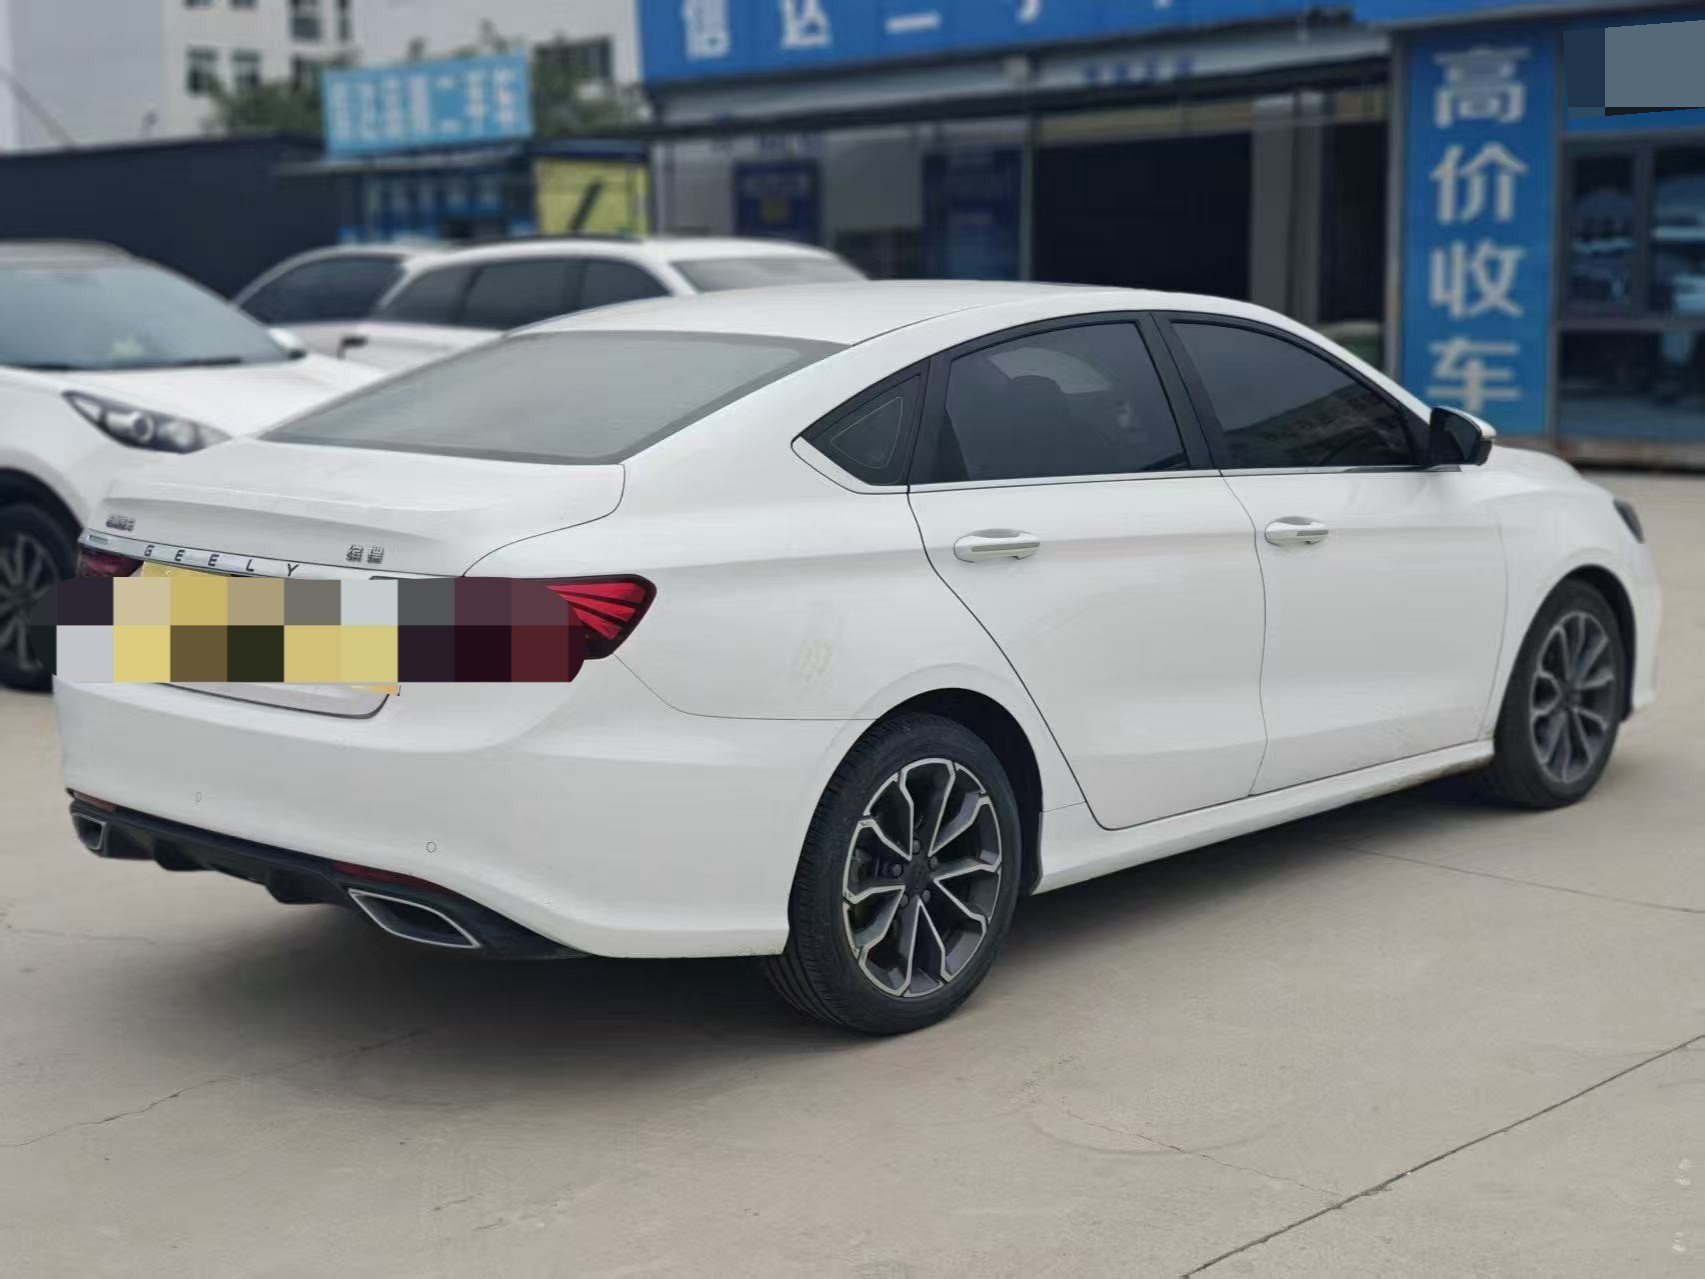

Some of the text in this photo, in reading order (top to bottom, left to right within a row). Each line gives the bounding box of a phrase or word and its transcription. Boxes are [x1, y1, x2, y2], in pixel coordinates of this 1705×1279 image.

[1426, 46, 1530, 412] 高价收车
[144, 544, 300, 578] GEELY
